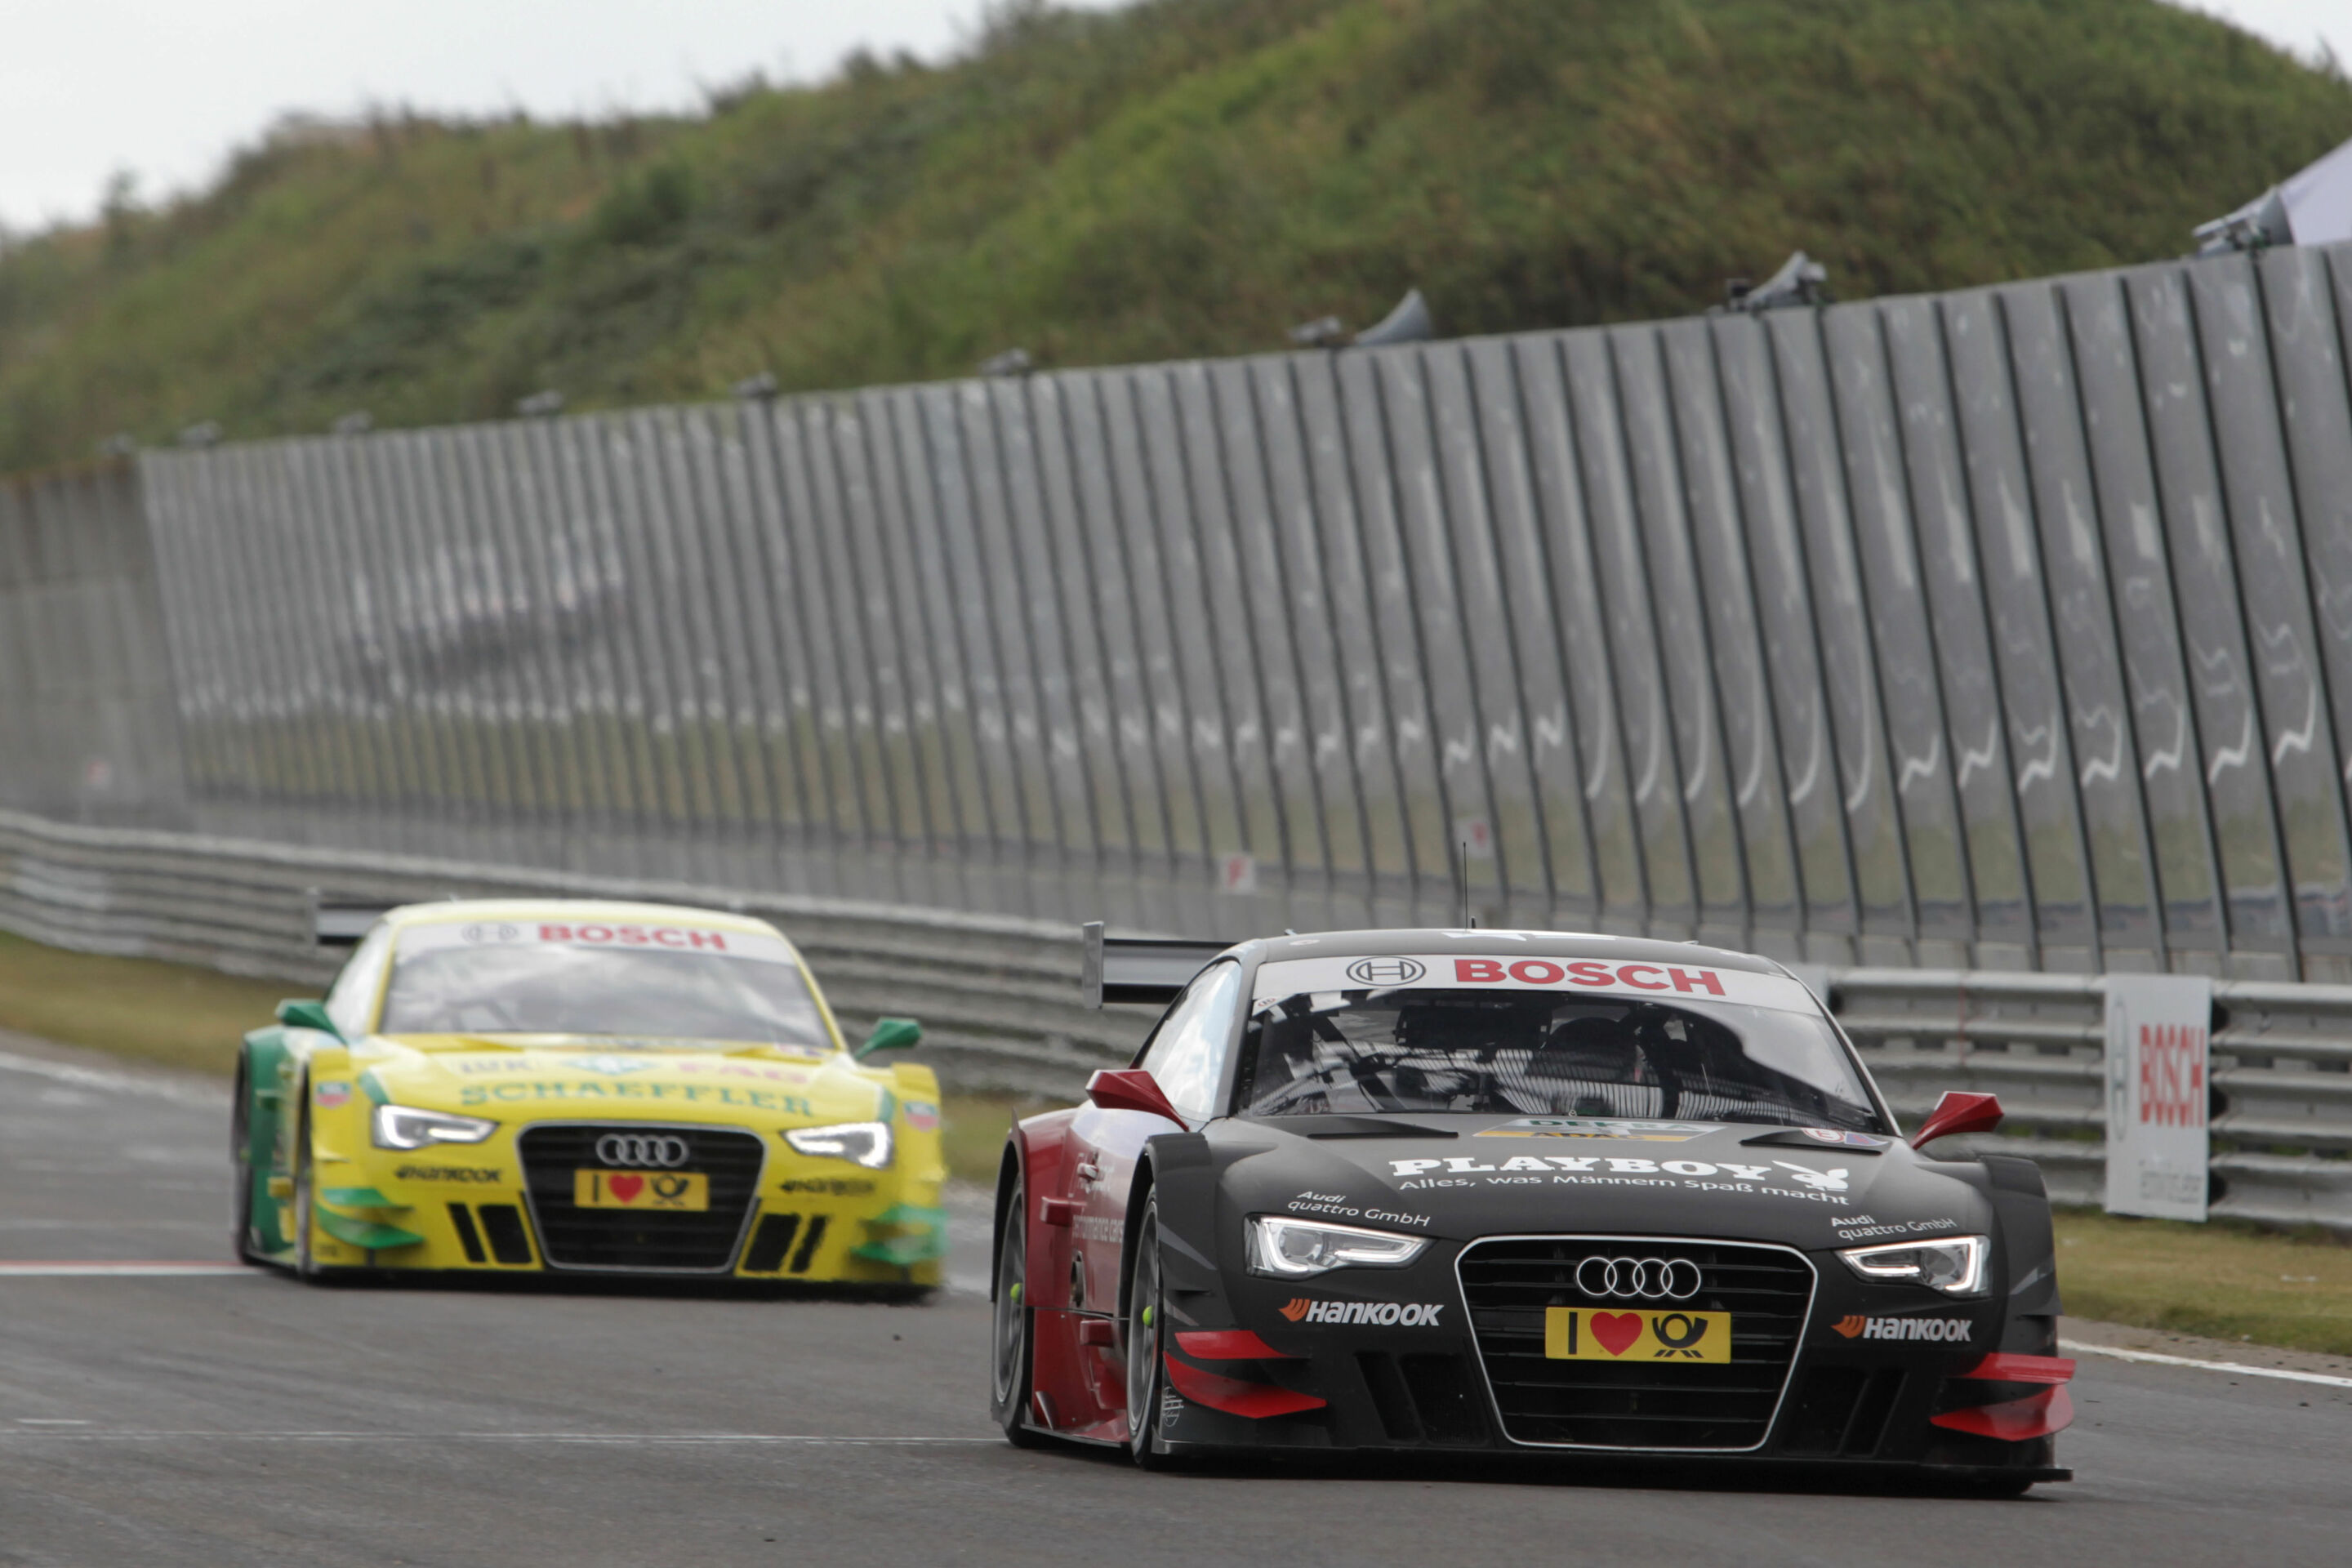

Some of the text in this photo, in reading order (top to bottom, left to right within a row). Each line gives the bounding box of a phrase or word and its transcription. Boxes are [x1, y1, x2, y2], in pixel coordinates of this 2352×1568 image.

[539, 924, 728, 951] BOSCH
[1454, 959, 1727, 996] BOSCH
[2140, 1023, 2205, 1129] BOSCH
[460, 1082, 814, 1119] SCHAEFFLER
[1529, 1119, 1701, 1131] DEKRA
[1388, 1156, 1772, 1181] PLAYBOY
[592, 1174, 599, 1202] I
[1297, 1191, 1347, 1204] Audi
[1399, 1175, 1850, 1206] Alles, was Männern Spaß macht
[1287, 1200, 1432, 1227] quattro GmbH
[1831, 1214, 1877, 1227] Audi
[1838, 1218, 1958, 1241] quattro GmbH
[1567, 1311, 1579, 1355] I
